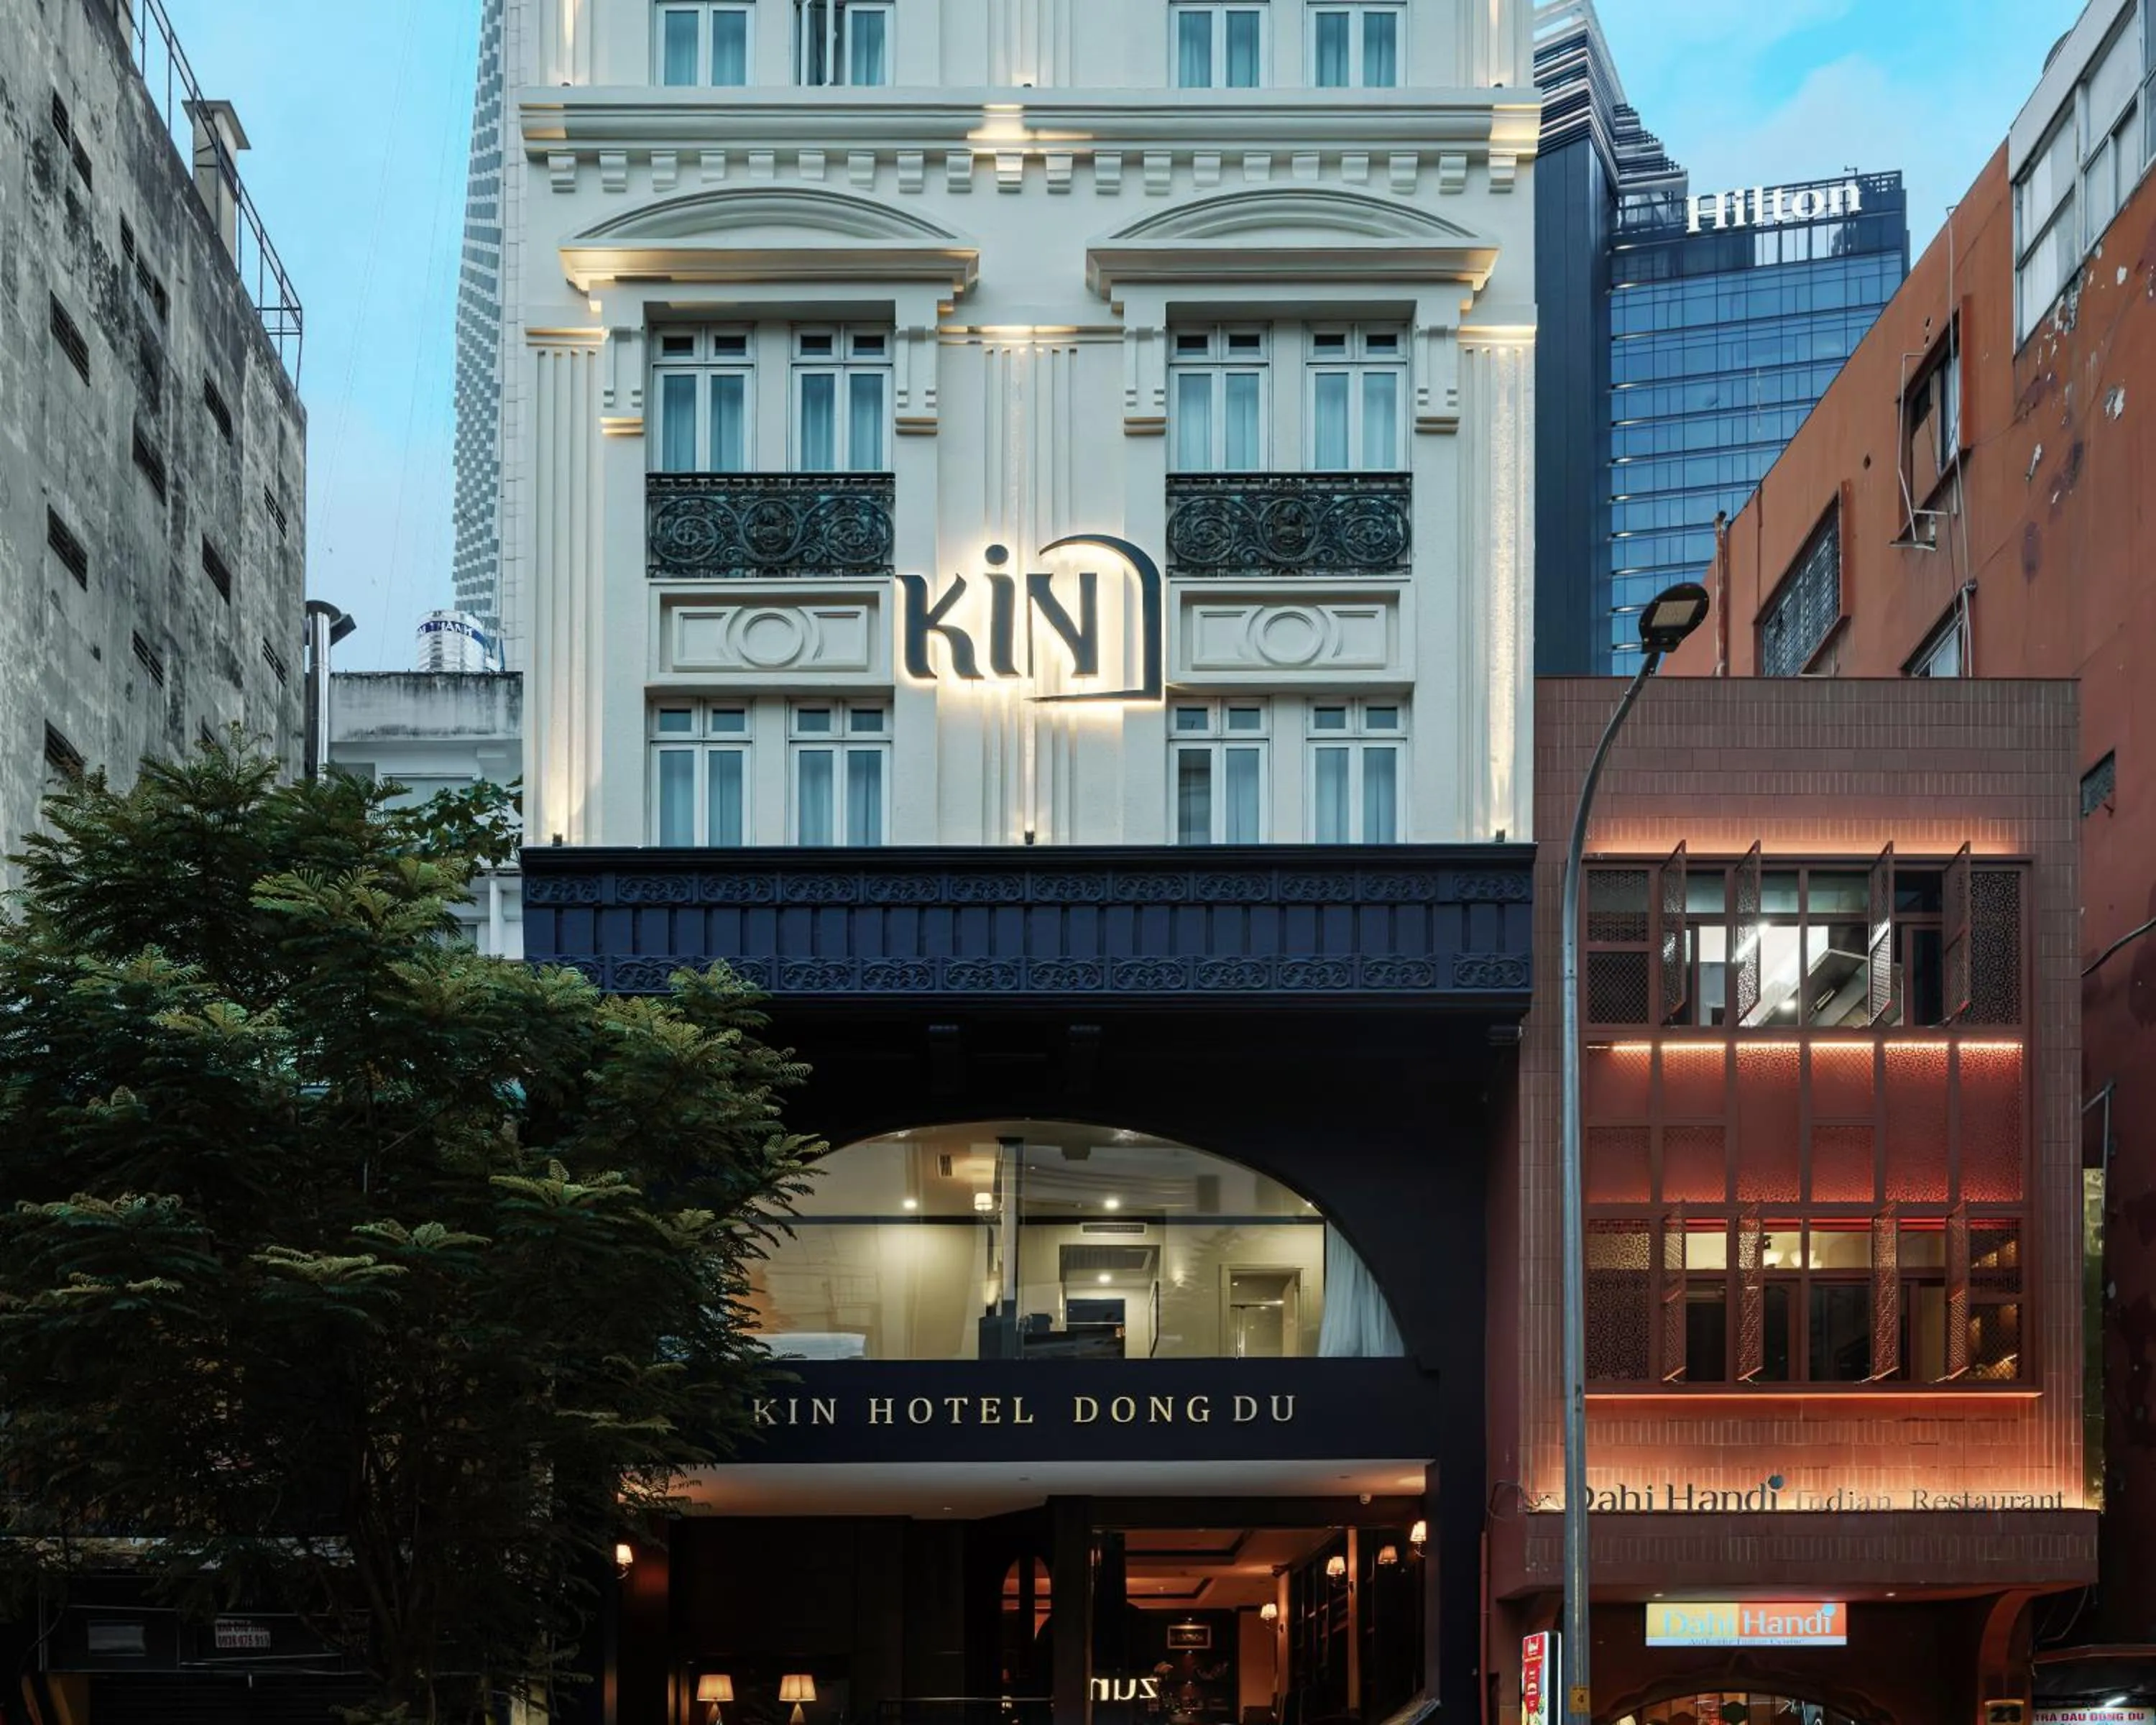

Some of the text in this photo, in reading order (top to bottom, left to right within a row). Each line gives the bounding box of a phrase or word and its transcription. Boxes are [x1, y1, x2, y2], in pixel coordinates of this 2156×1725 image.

[1686, 184, 1863, 233] Hilton
[752, 1395, 1294, 1425] KIN HOTEL DONG DU
[1667, 1475, 1784, 1510] Handi
[1797, 1488, 1892, 1510] Indian
[1912, 1489, 2066, 1510] Restaurant
[1663, 1604, 1836, 1635] Dahi Handi
